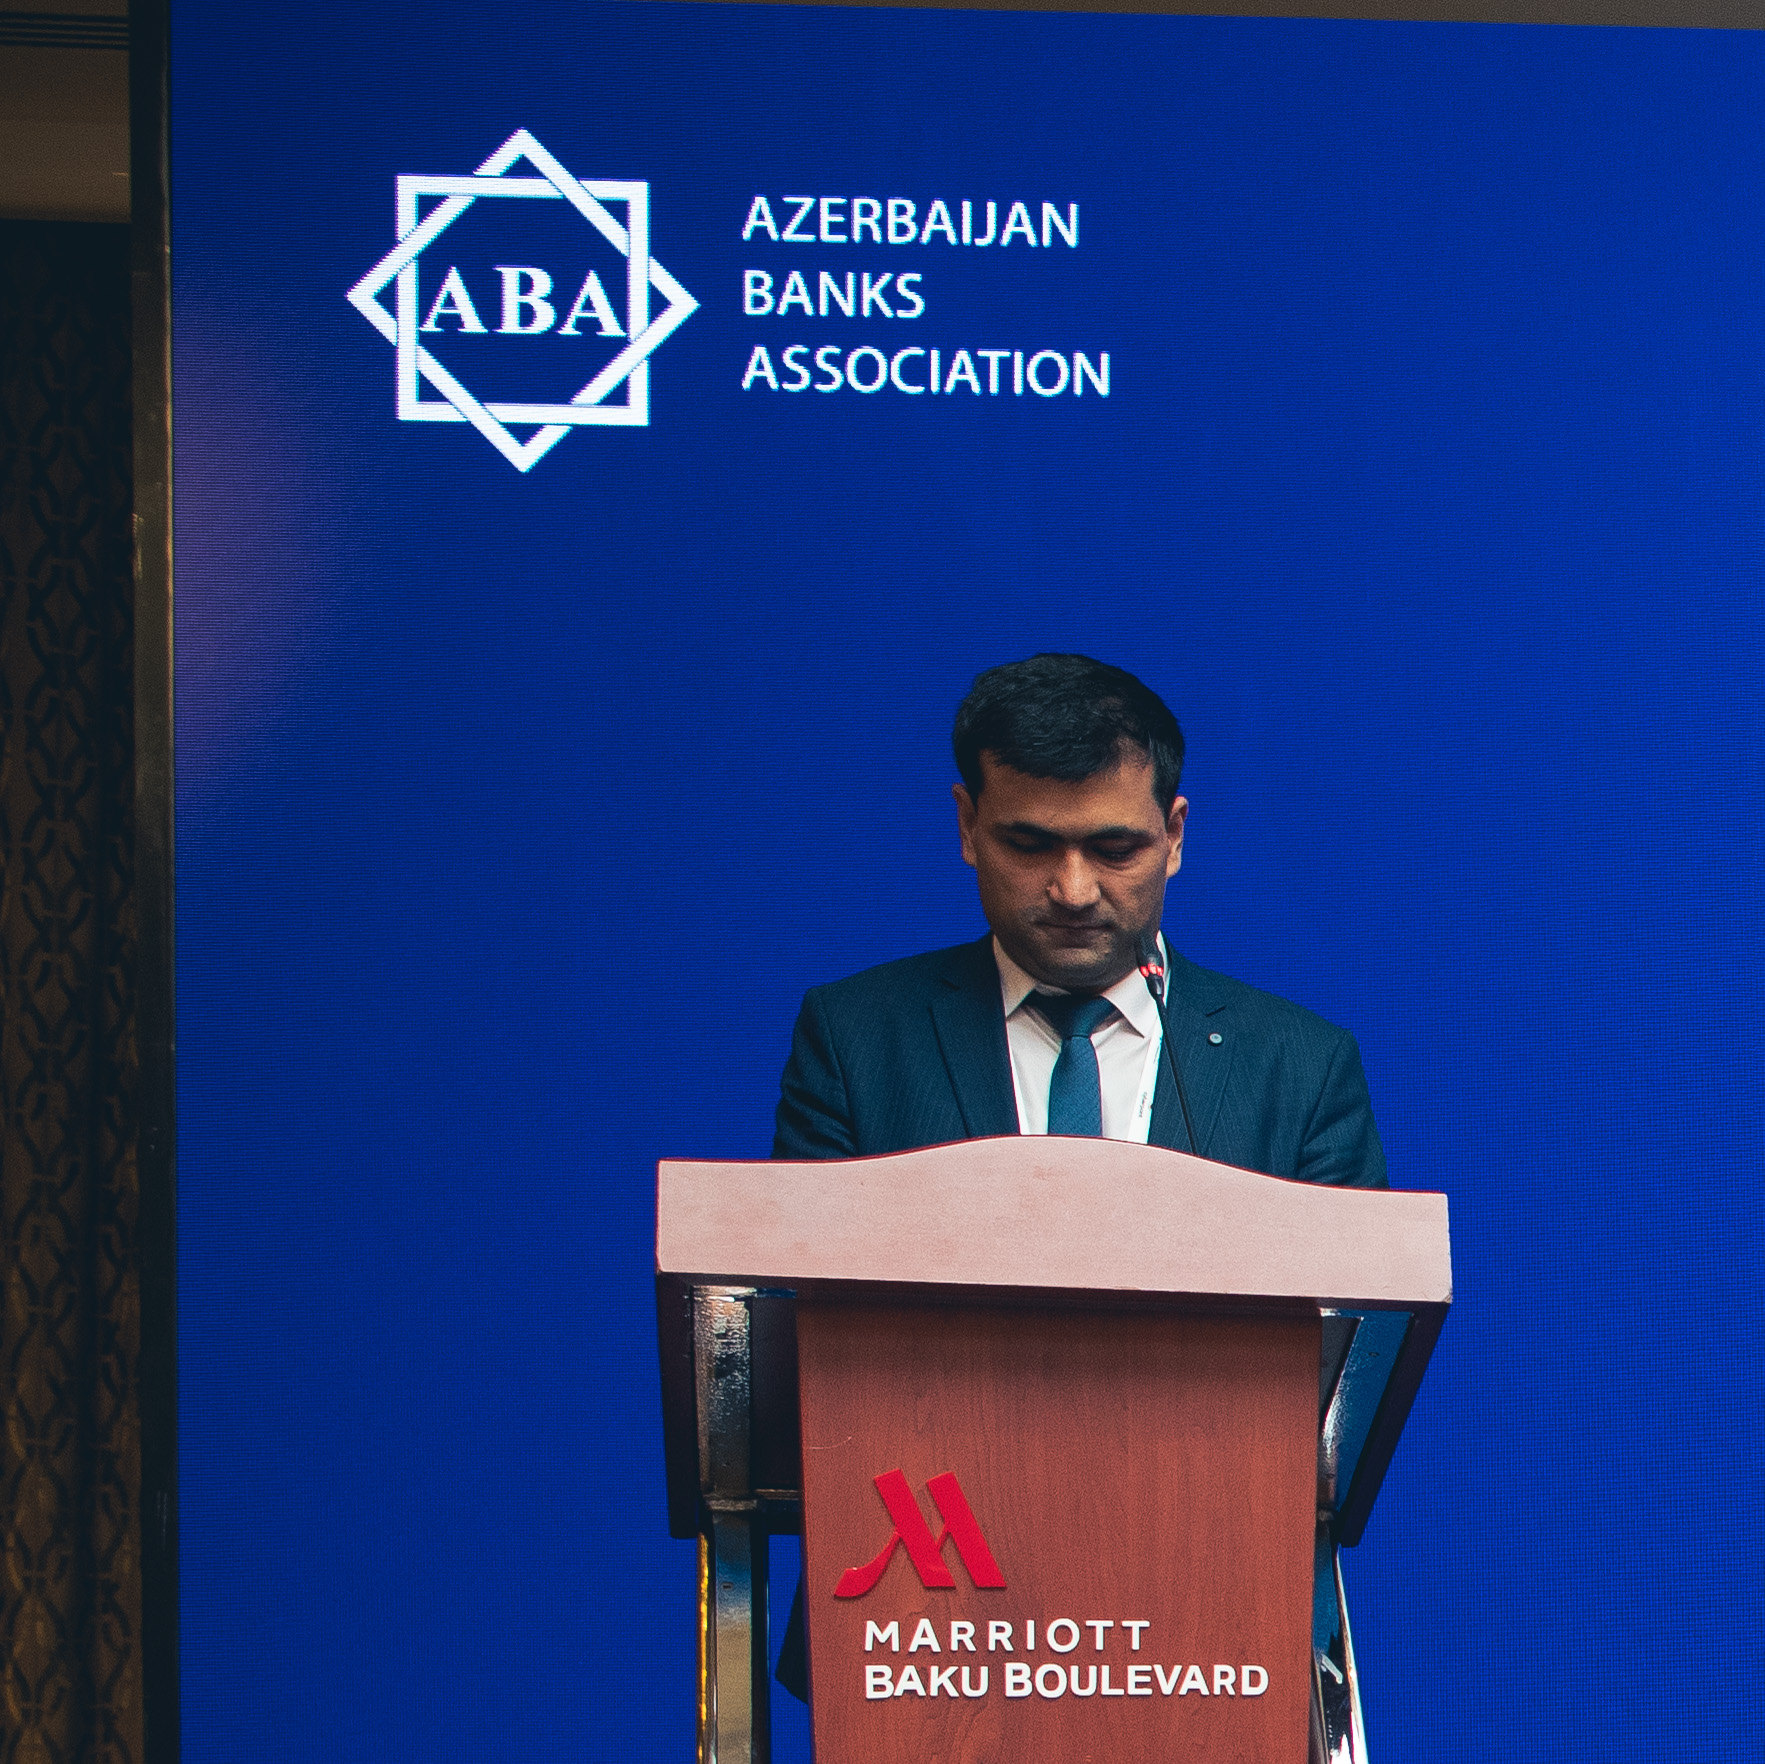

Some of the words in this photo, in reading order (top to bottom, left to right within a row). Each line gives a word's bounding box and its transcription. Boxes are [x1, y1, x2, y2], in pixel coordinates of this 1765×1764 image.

[741, 195, 1079, 248] AZERBAIJAN
[419, 265, 626, 336] ABA
[743, 269, 926, 318] BANKS
[741, 344, 1111, 397] ASSOCIATION
[864, 1618, 1150, 1653] MARRIOTT
[865, 1664, 989, 1699] BAKU
[1005, 1662, 1269, 1699] BOULEVARD
